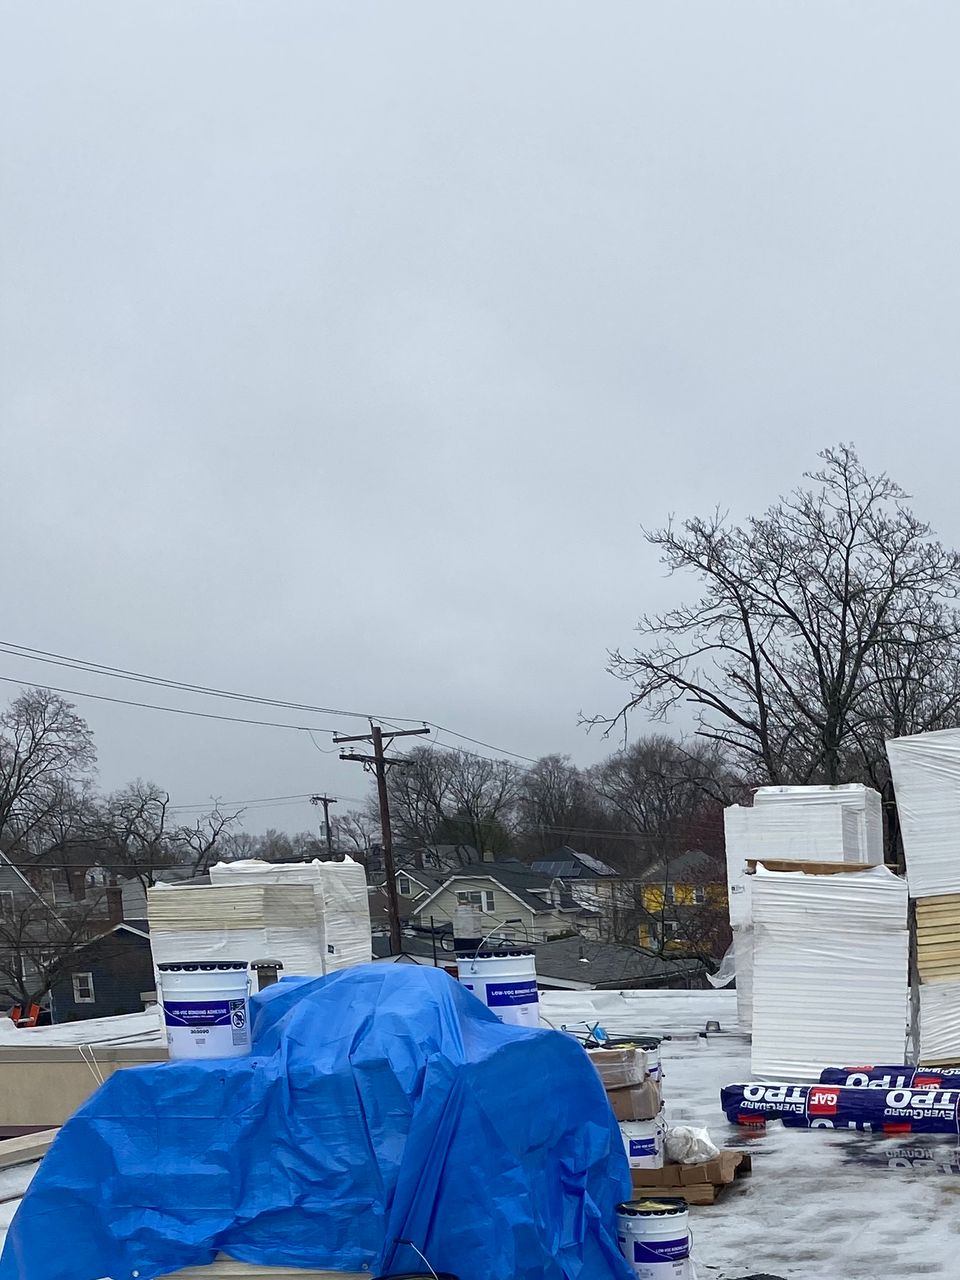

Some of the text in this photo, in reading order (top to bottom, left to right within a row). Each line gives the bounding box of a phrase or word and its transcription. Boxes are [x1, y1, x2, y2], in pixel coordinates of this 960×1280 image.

[743, 1086, 805, 1102] TPO
[810, 1092, 838, 1106] GAF
[886, 1090, 956, 1109] TPO
[884, 1108, 954, 1120] EVERGUARD
